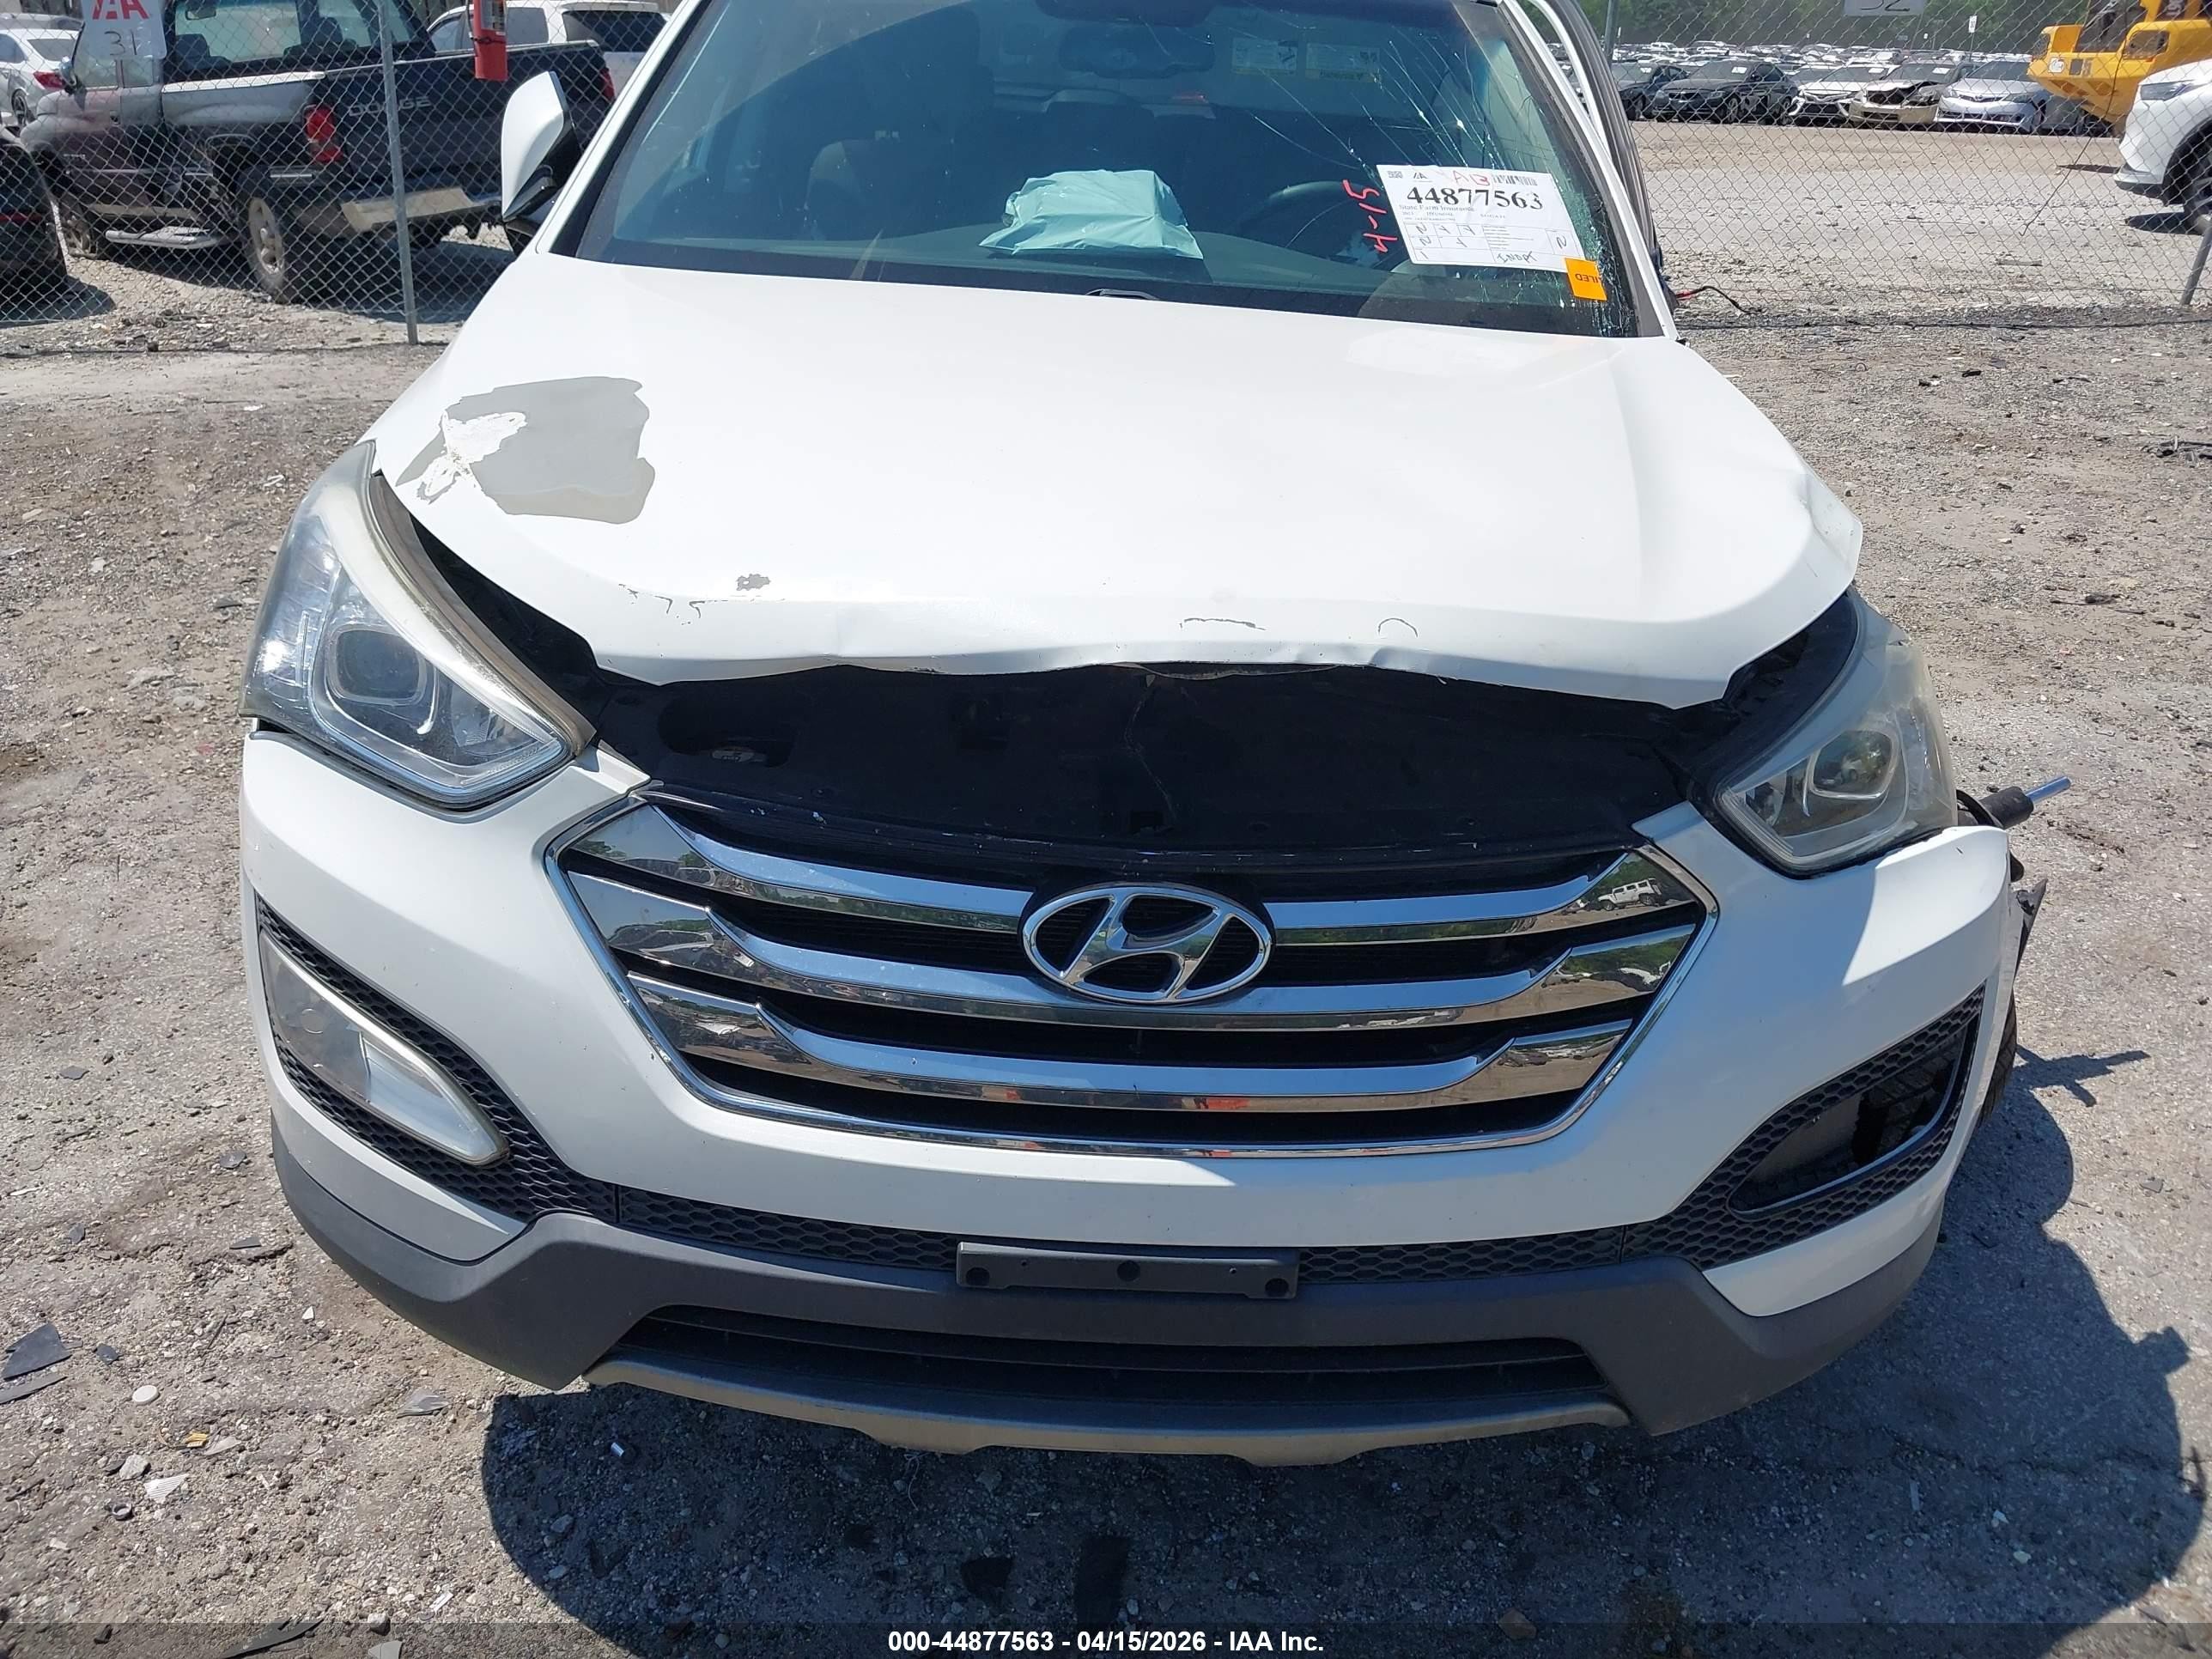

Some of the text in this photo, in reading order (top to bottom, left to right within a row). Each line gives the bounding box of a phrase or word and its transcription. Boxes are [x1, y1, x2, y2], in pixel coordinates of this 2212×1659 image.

[349, 96, 431, 117] DOGE
[1407, 186, 1544, 210] 44877563
[1575, 273, 1602, 284] ILED
